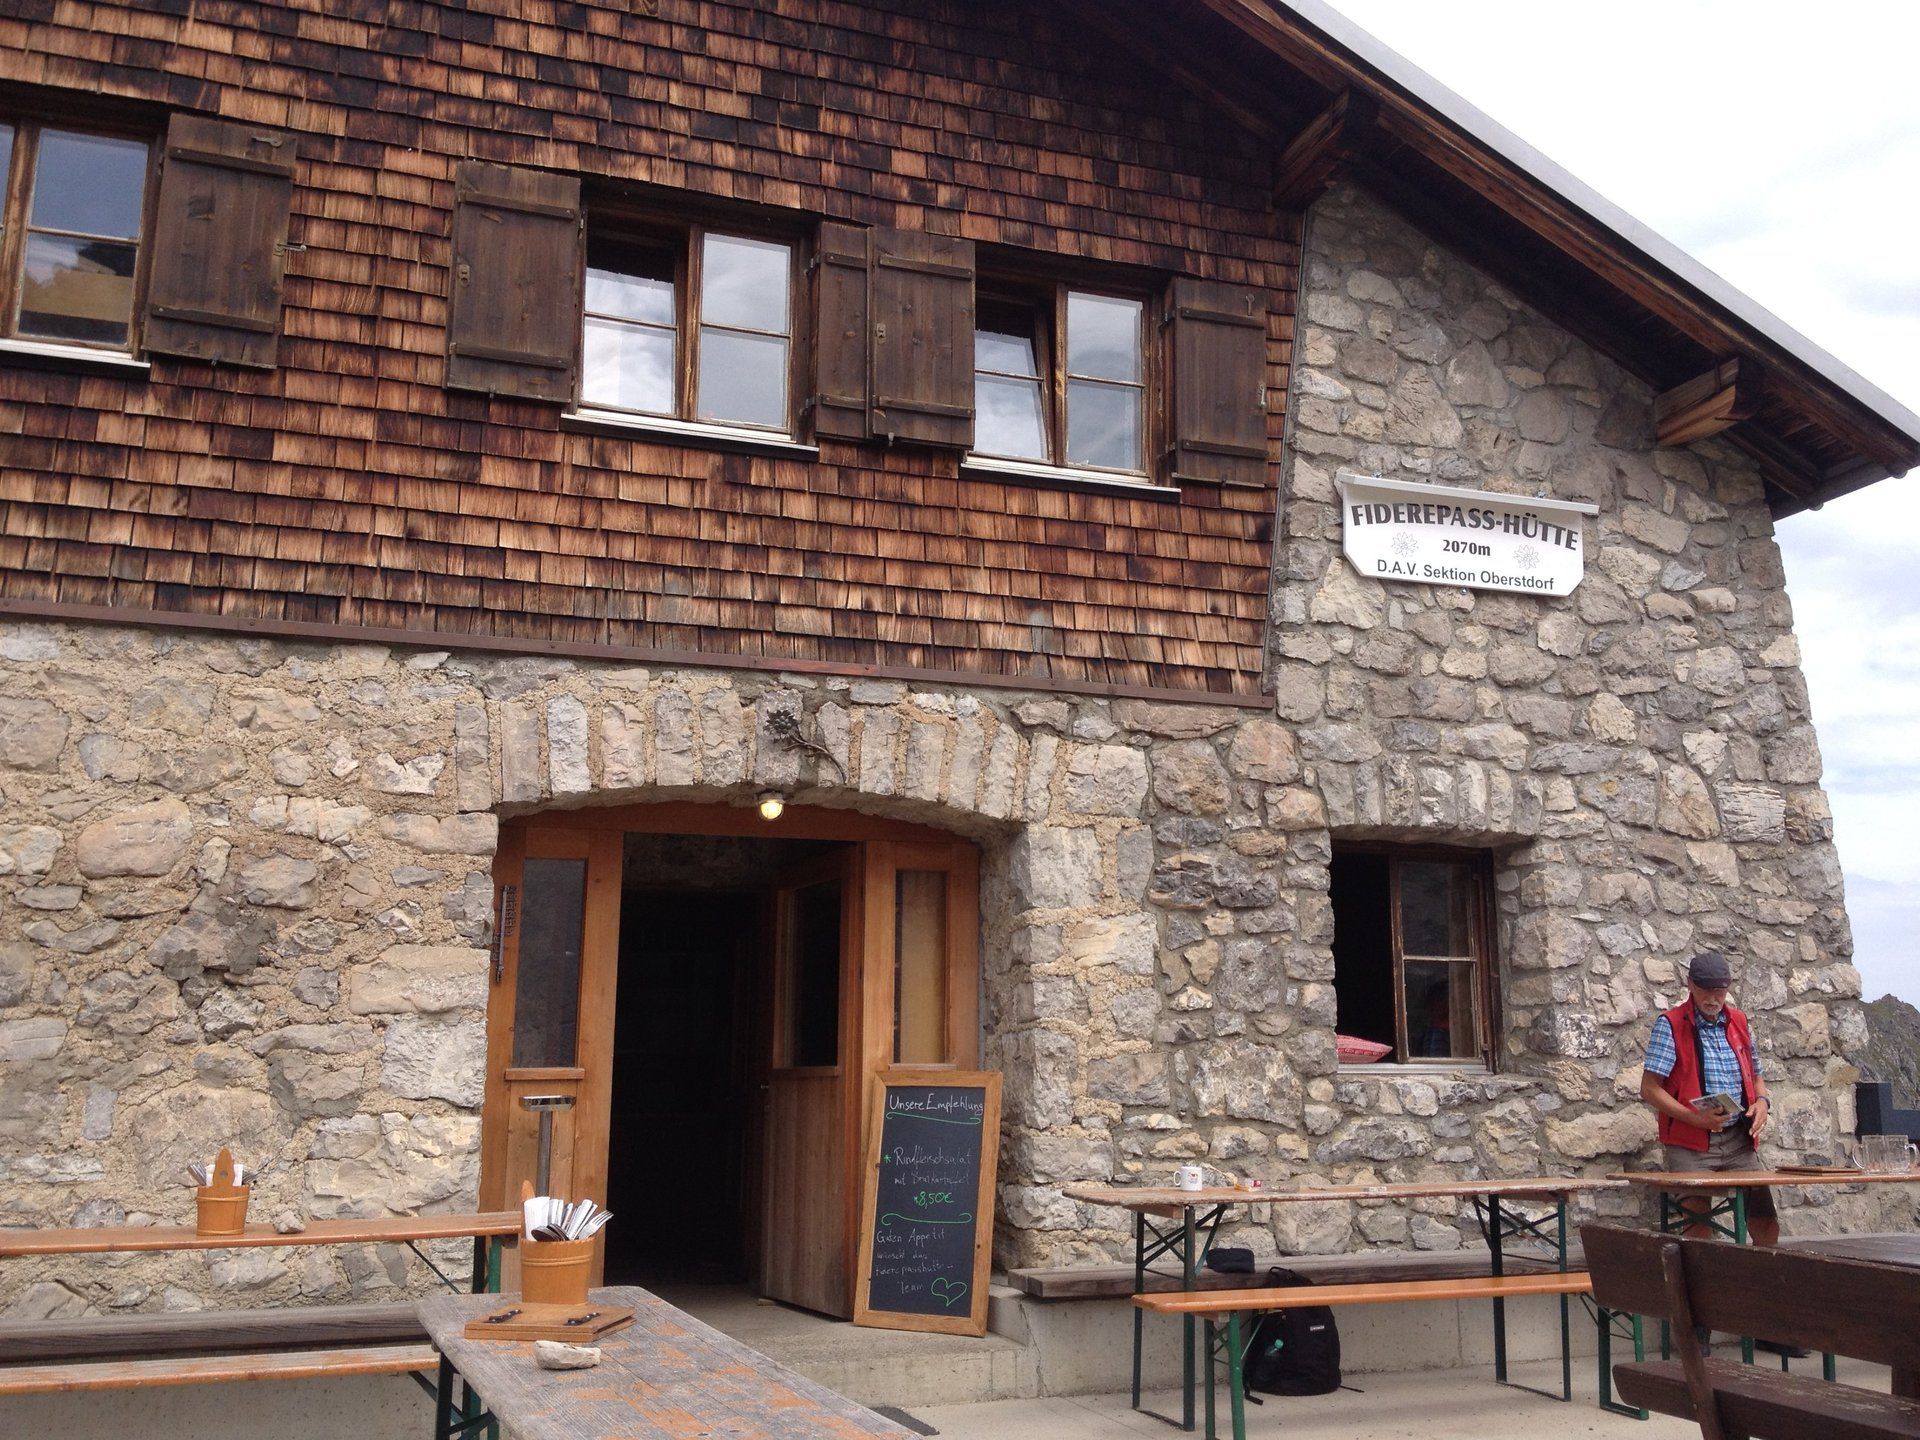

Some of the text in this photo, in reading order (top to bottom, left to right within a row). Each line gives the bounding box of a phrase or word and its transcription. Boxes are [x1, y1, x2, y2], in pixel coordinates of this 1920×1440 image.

[1351, 503, 1579, 550] FIDEREPASS-HÜTTE
[1443, 539, 1491, 556] 2070m
[1377, 559, 1555, 590] D.A.V. Sektion Oberstdorf
[889, 1092, 983, 1116] Unsere Empfehlung
[877, 1230, 902, 1243] Guten
